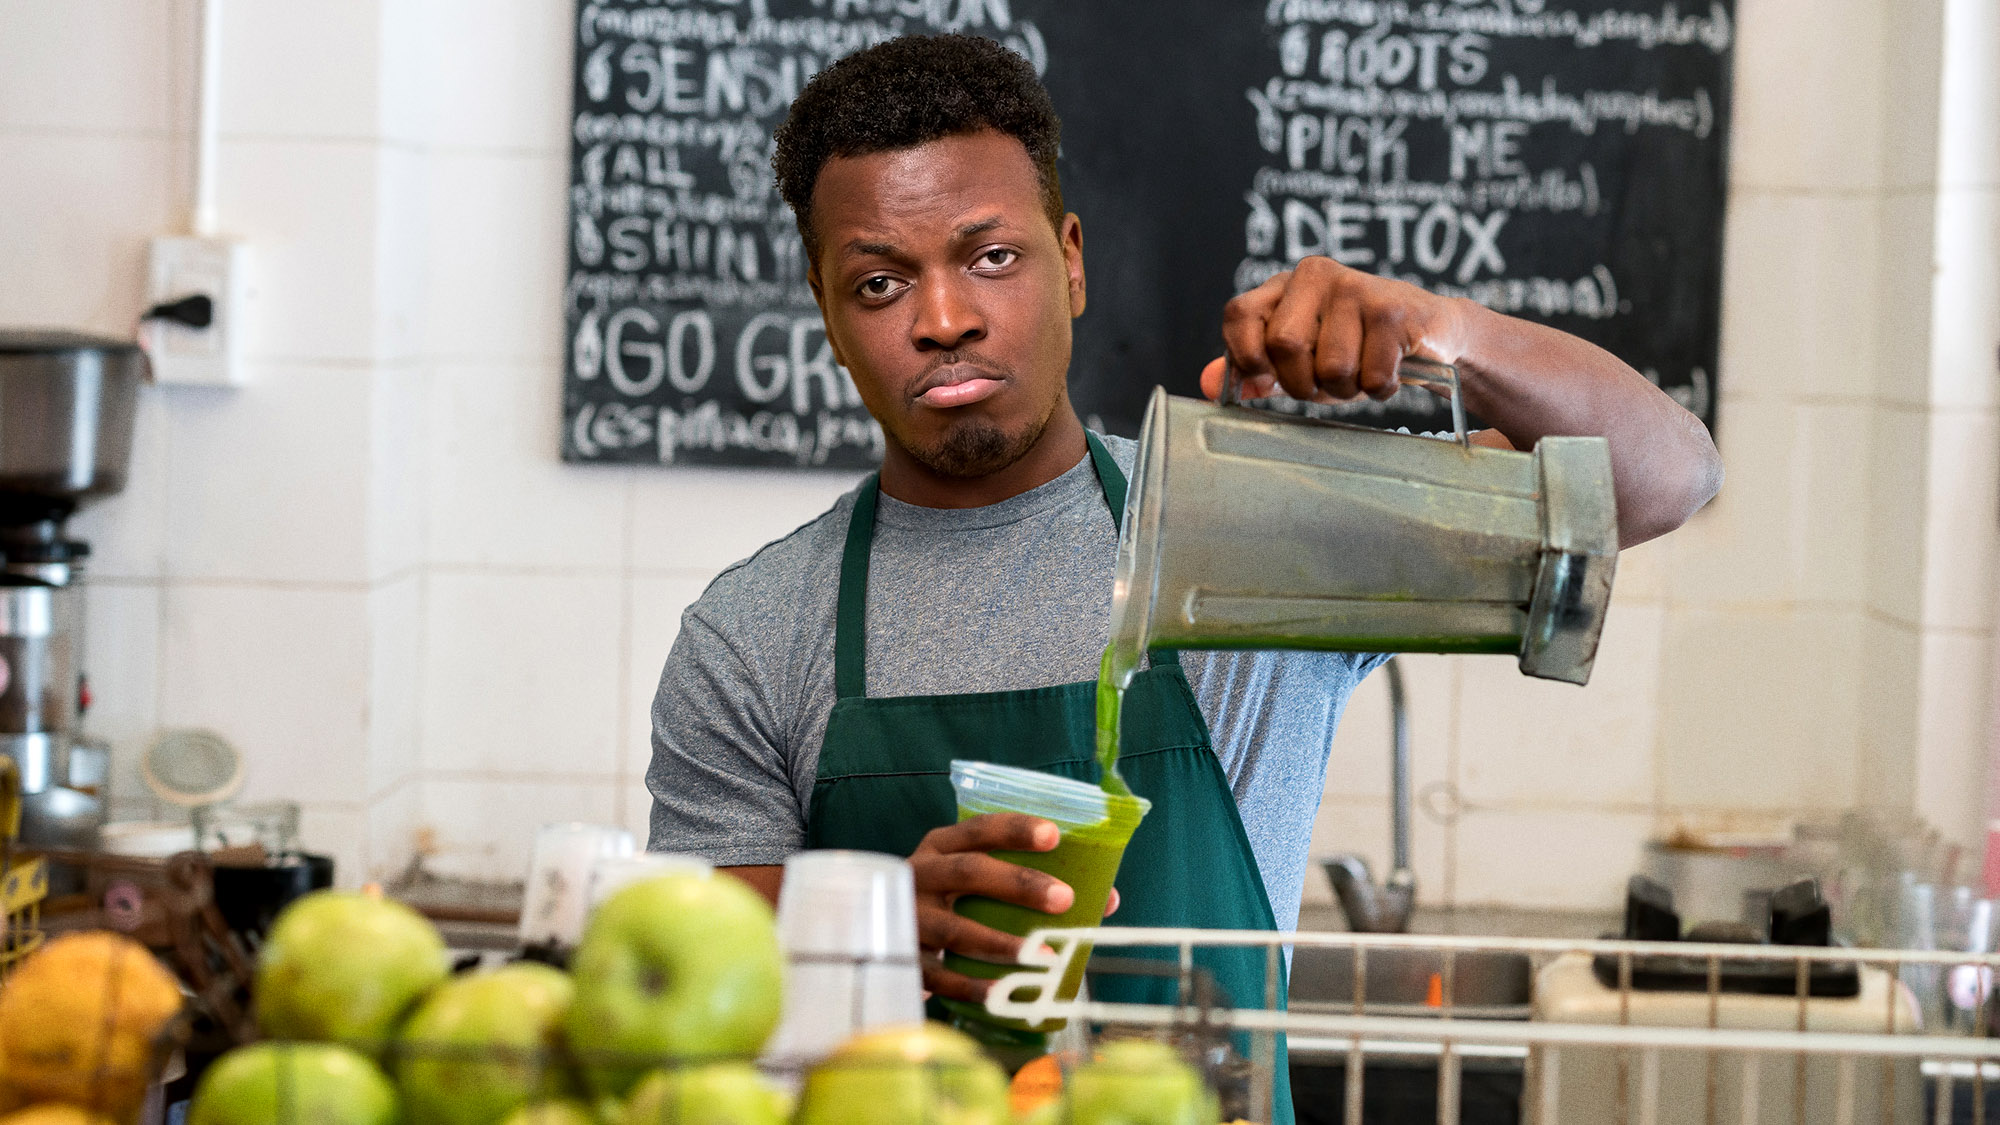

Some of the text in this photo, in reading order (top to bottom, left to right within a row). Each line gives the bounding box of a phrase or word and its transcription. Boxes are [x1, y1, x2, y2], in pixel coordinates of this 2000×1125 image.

[1287, 113, 1531, 190] PICK ME
[1284, 200, 1508, 284] DETOX
[604, 306, 863, 415] GO GR
